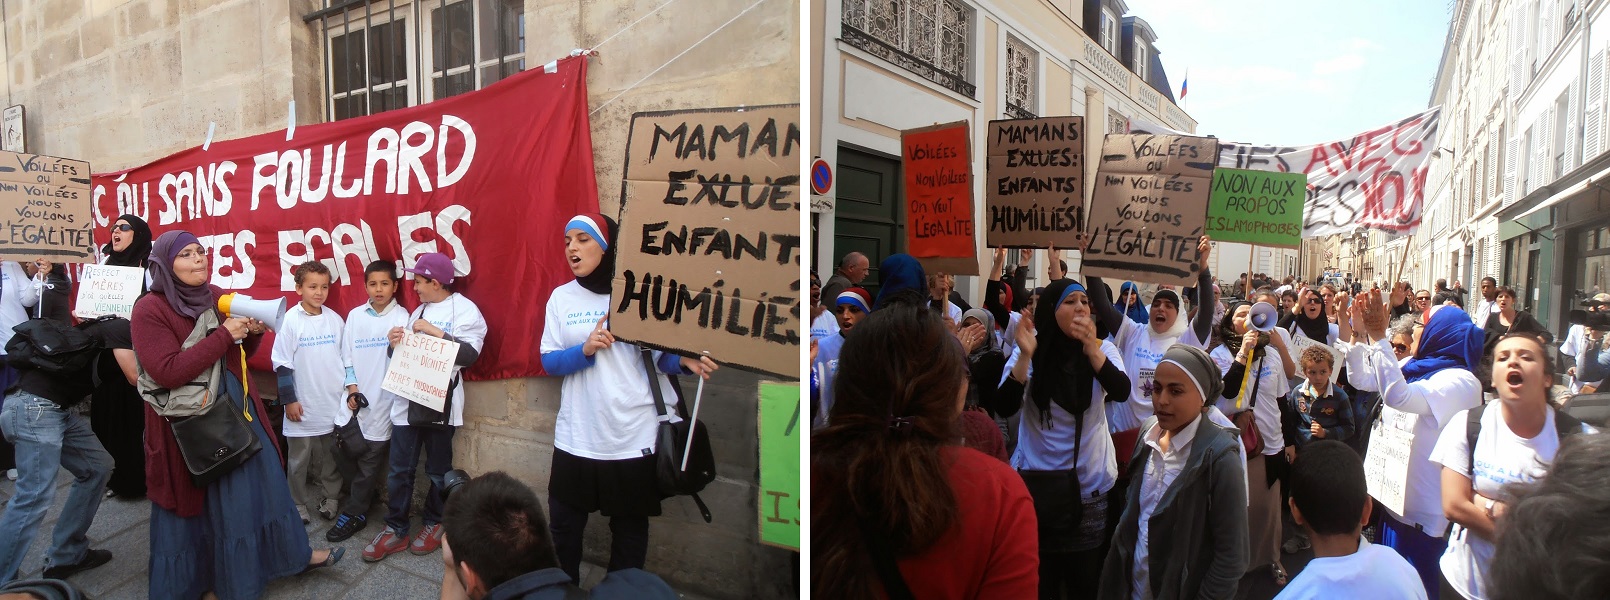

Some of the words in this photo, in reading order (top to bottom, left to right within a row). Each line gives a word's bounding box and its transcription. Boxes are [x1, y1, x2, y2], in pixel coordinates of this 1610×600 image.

[998, 122, 1079, 146] MAMANS
[1007, 147, 1078, 168] EXLUES:
[1147, 161, 1162, 171] OU
[37, 175, 51, 183] OU
[159, 161, 237, 225] SANS
[250, 115, 477, 211] FOULARD
[663, 170, 800, 211] EXLUE
[998, 176, 1077, 195] ENFANTS
[1215, 172, 1258, 195] NON
[1261, 177, 1297, 197] AUX
[28, 200, 62, 209] NOUS
[1131, 196, 1169, 206] NOUS
[1226, 196, 1287, 215] PROPOS
[15, 206, 75, 224] VOULONS
[1116, 203, 1182, 227] VOULONS
[1206, 216, 1300, 237] ISLAMOPHOBES
[640, 221, 800, 266] ENFANT
[84, 266, 120, 279] RESPECT
[92, 279, 124, 291] MÈRES
[95, 302, 132, 313] VIENNENT
[400, 332, 446, 354] RESPECT
